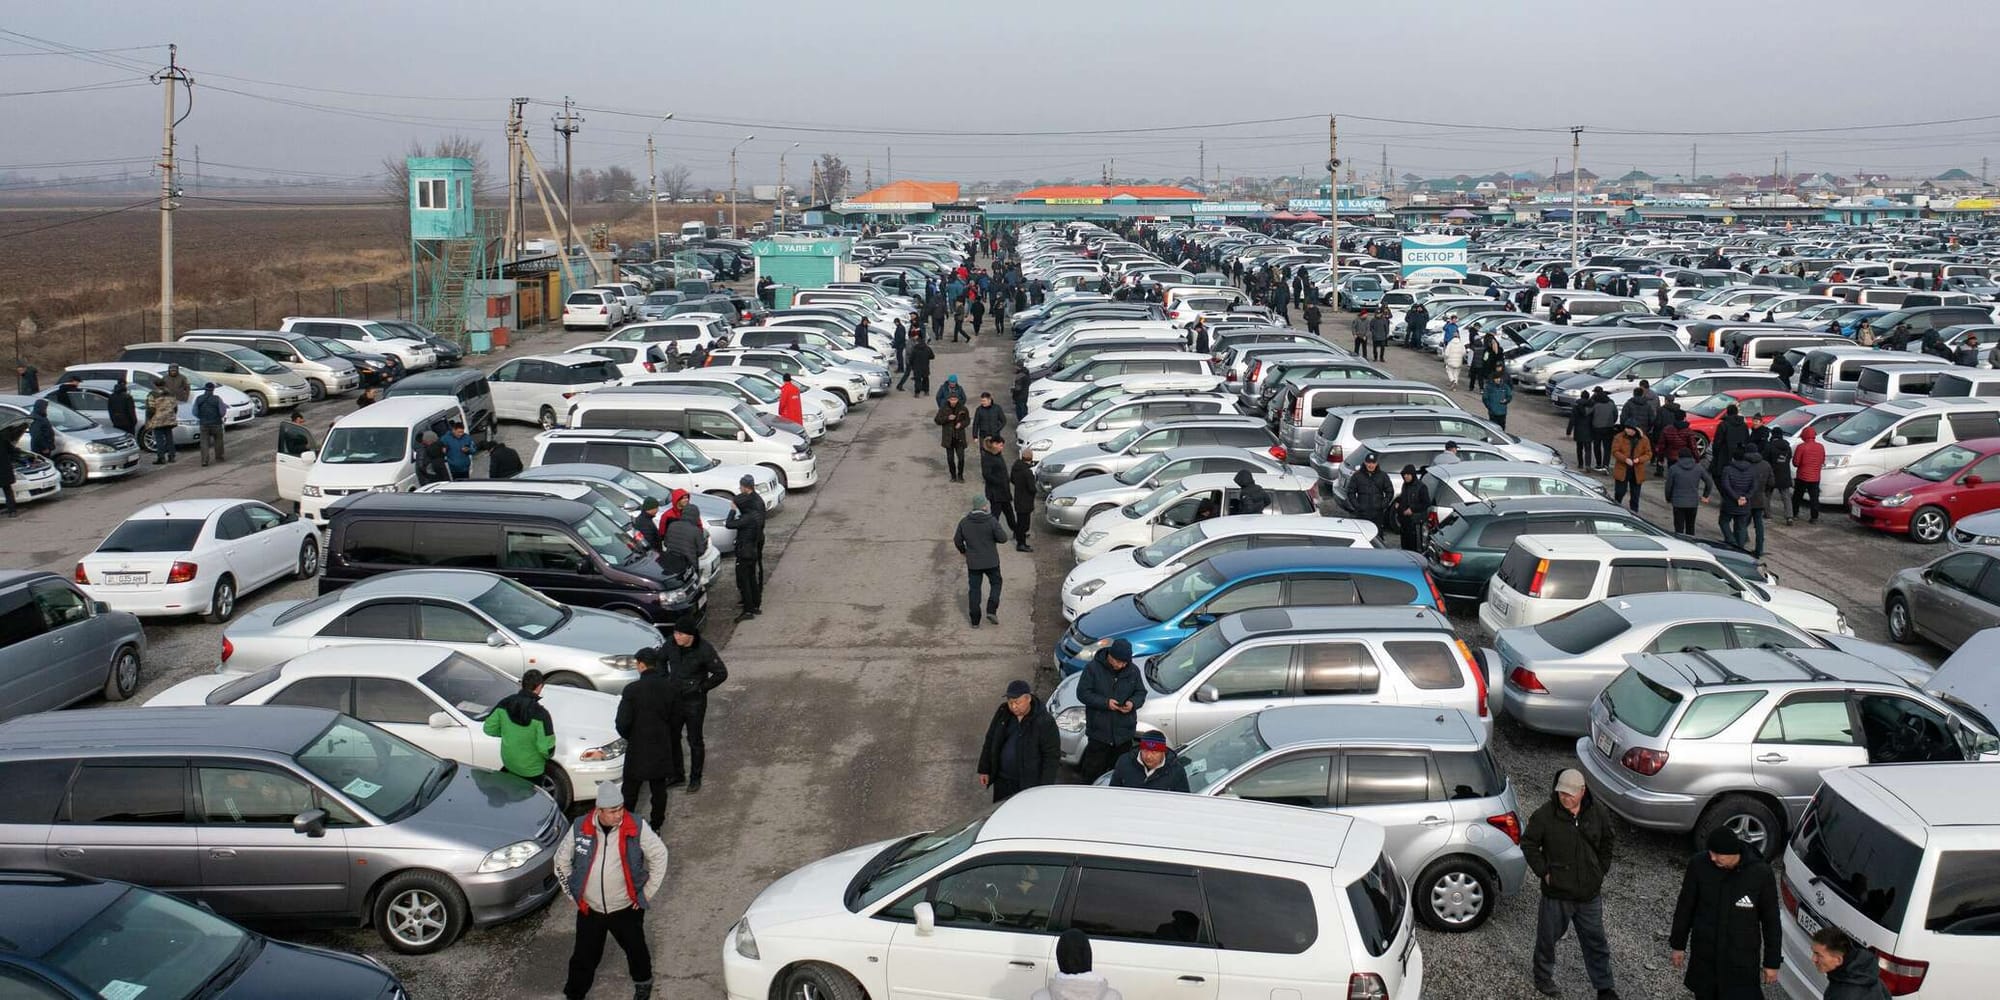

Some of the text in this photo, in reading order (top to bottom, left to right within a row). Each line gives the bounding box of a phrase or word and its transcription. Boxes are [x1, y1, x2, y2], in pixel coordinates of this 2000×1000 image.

[1289, 199, 1323, 207] КАДЫР
[1325, 199, 1344, 207] АА
[778, 244, 813, 252] ТУАЛЕТ
[1408, 252, 1463, 261] СЕКТОР 1
